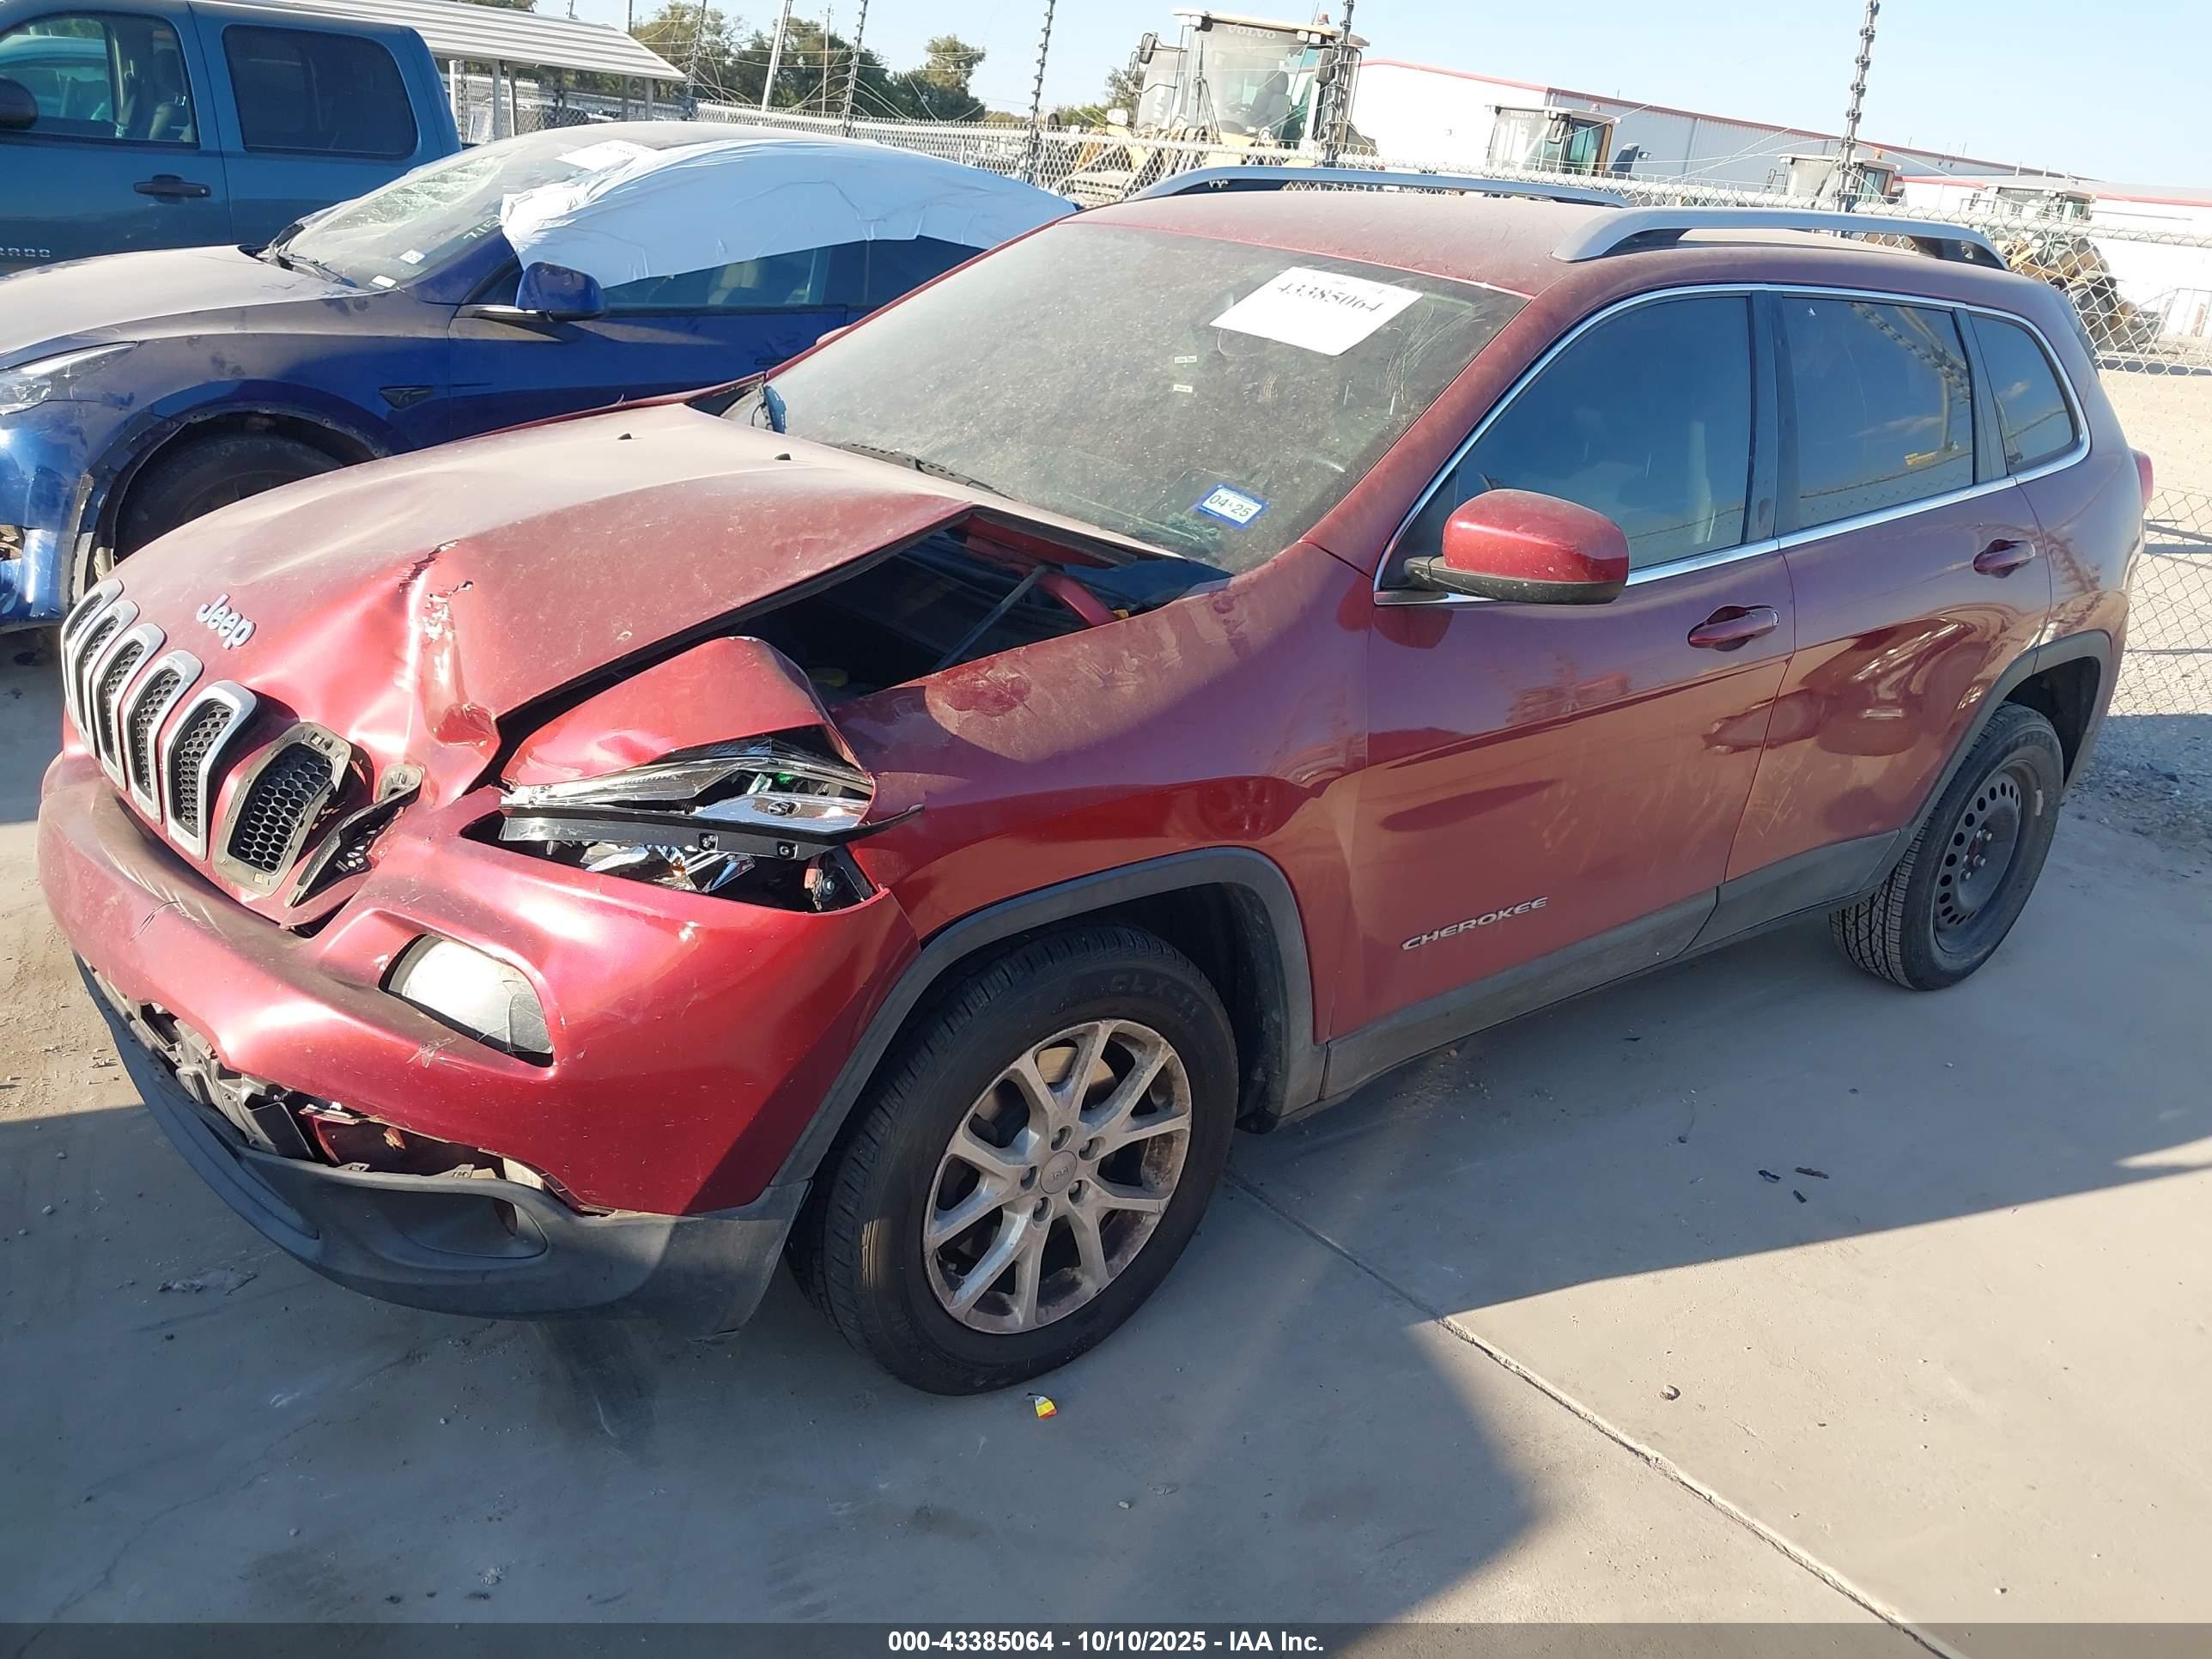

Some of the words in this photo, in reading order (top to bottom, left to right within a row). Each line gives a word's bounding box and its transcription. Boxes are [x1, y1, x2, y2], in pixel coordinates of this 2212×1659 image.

[1228, 27, 1277, 40] VOLVO
[196, 592, 257, 650] Jeep
[1401, 896, 1549, 951] CHEROKEE
